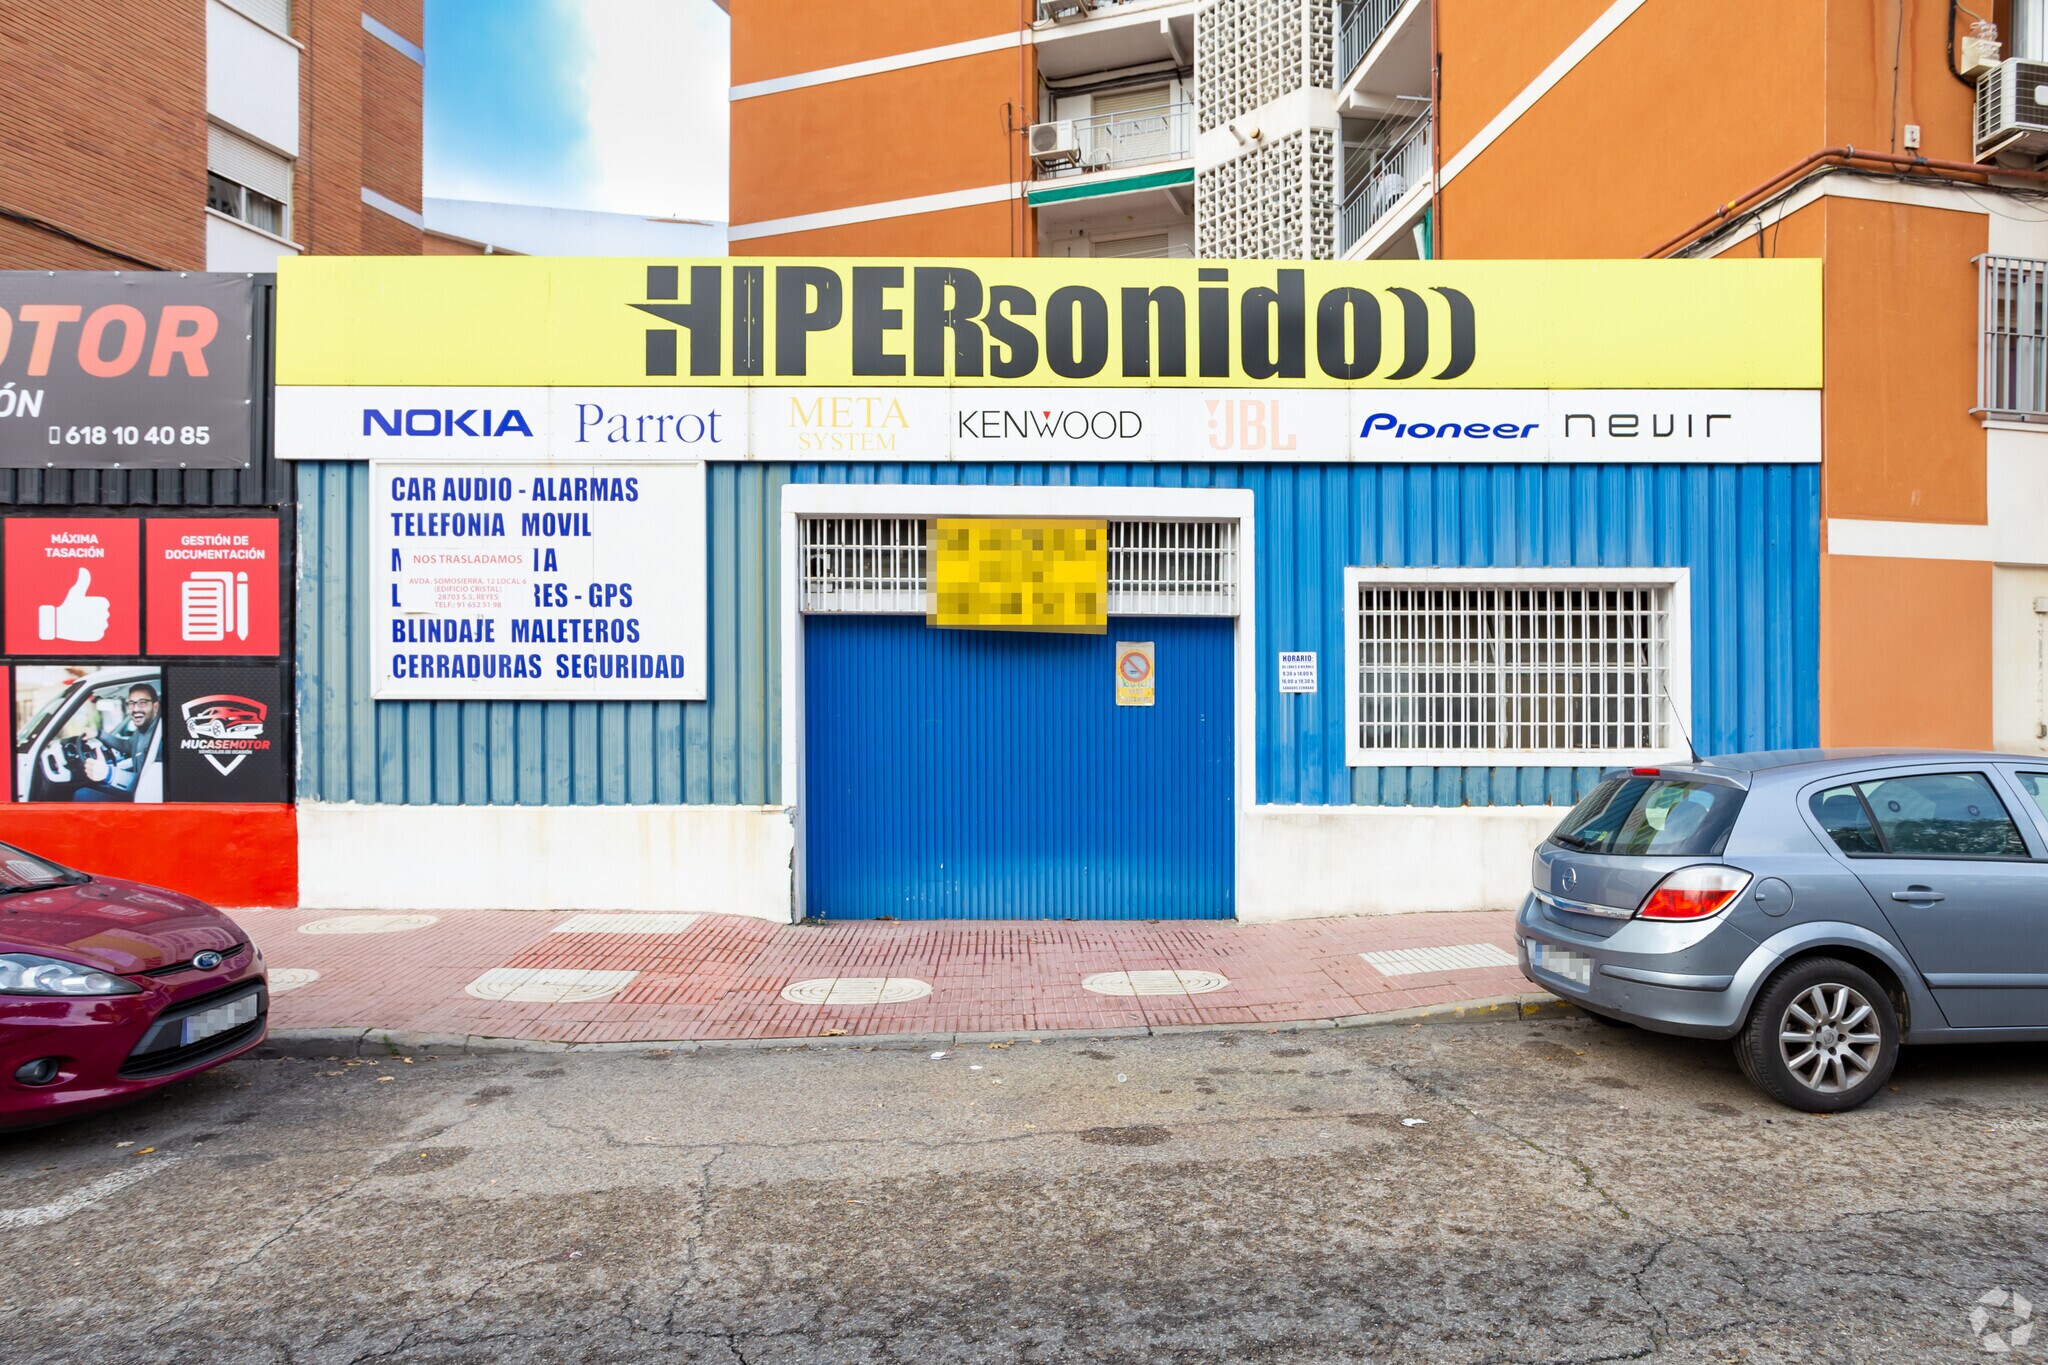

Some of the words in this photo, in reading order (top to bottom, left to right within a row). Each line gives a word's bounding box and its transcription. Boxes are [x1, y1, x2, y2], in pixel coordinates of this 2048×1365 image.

[0, 303, 219, 378] TOR
[363, 408, 533, 437] NOKIA
[575, 403, 722, 444] Parrot
[790, 396, 910, 429] META
[958, 410, 1143, 440] KENWOOD
[1207, 399, 1297, 451] JBL
[65, 425, 107, 445] 618
[111, 425, 139, 445] 10
[143, 425, 176, 445] 40
[179, 425, 210, 445] 85
[1359, 412, 1540, 440] Pioneer
[798, 432, 896, 451] SYSTEM
[391, 476, 436, 502] CAR
[442, 476, 512, 502] AUDIO
[531, 476, 639, 502] ALARMAS
[391, 512, 506, 537] TELEFONIA
[521, 512, 592, 537] MOVIL
[45, 545, 104, 558] TASACIÓN
[51, 532, 98, 545] MÁXIMA
[181, 533, 231, 546] GESTIÓN
[233, 535, 249, 546] DE
[165, 548, 265, 560] DOCUMENTACIÓN
[413, 555, 436, 564] NOS
[439, 555, 523, 564] TRASLADAMOS
[588, 582, 633, 608] GPS
[392, 618, 495, 643] BLINDAJE
[511, 618, 640, 644] MALETEROS
[392, 653, 542, 679] CERRADURAS
[556, 653, 685, 679] SEGURIDAD
[181, 739, 270, 750] MUCASEMOTOR
